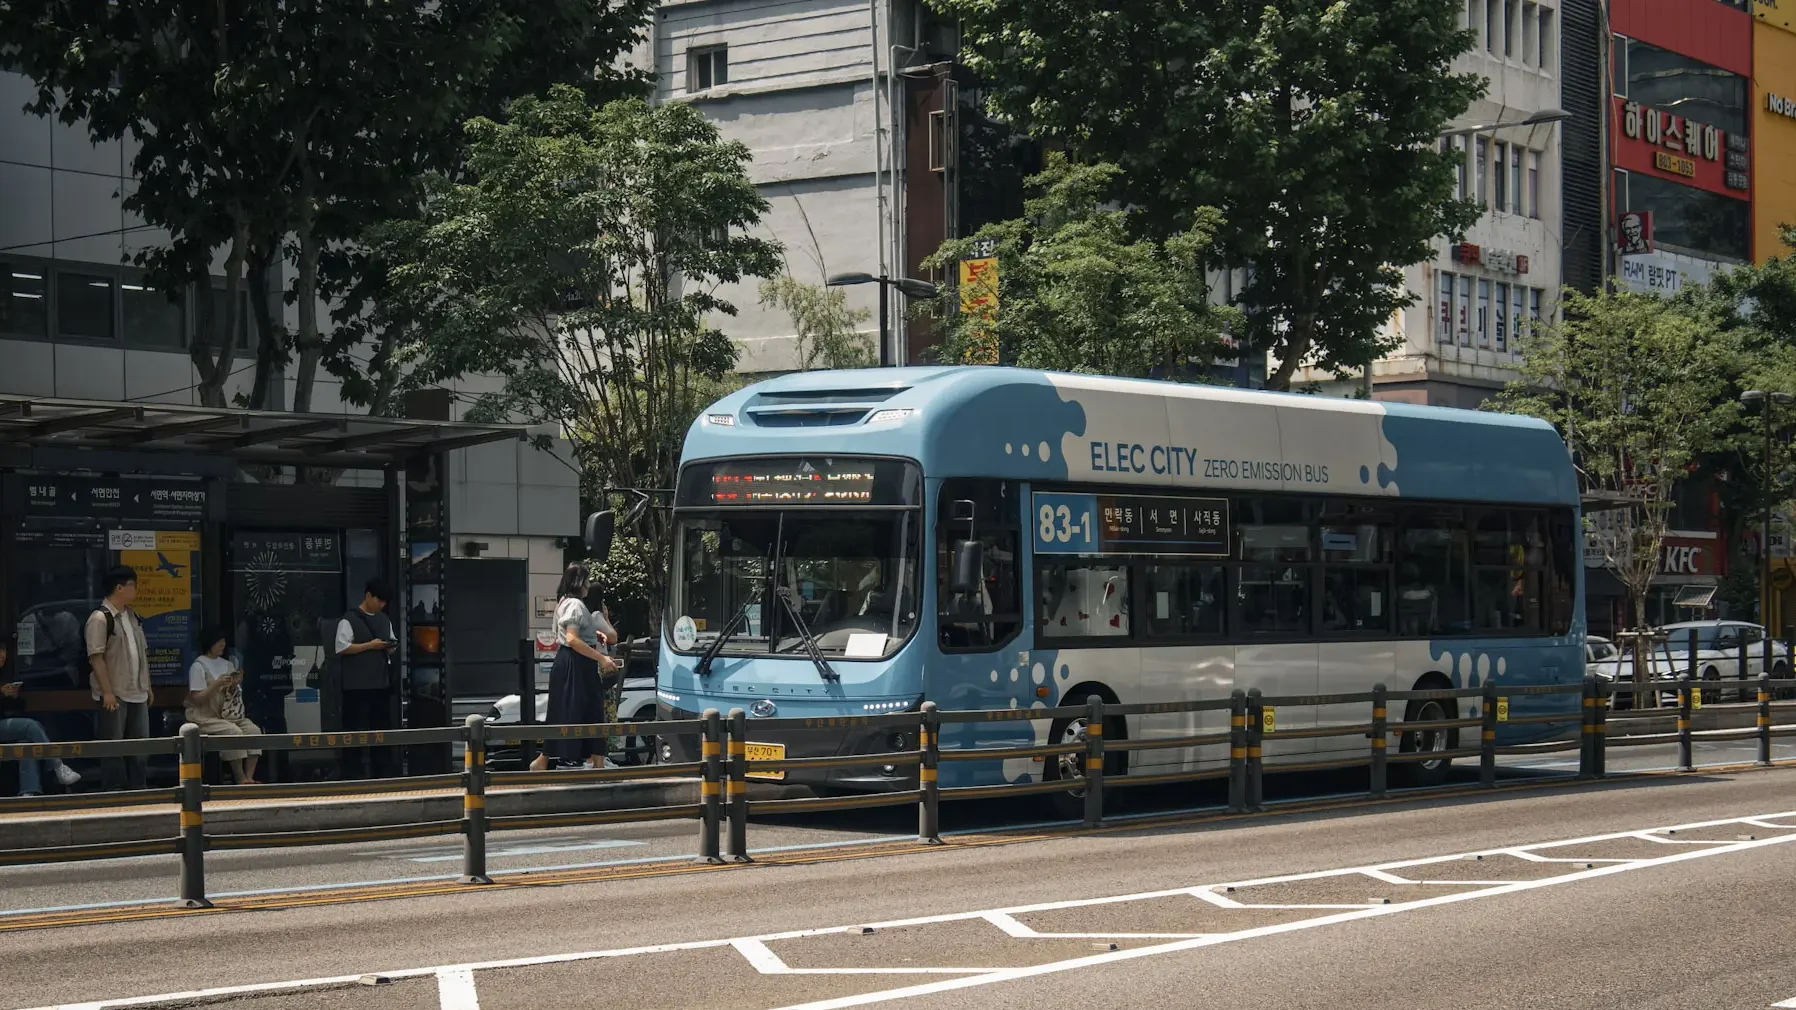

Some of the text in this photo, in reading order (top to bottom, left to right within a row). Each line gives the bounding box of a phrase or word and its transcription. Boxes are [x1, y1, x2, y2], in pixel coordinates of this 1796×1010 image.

[1625, 102, 1719, 161] 하이스퀘어
[1666, 269, 1677, 290] PT
[1090, 441, 1329, 483] ELEC CITY ZERO EMISSION BUS
[1039, 504, 1091, 543] 83-1
[1104, 508, 1133, 524] 민락동
[1193, 510, 1221, 526] 사직동
[1664, 546, 1702, 573] KFC
